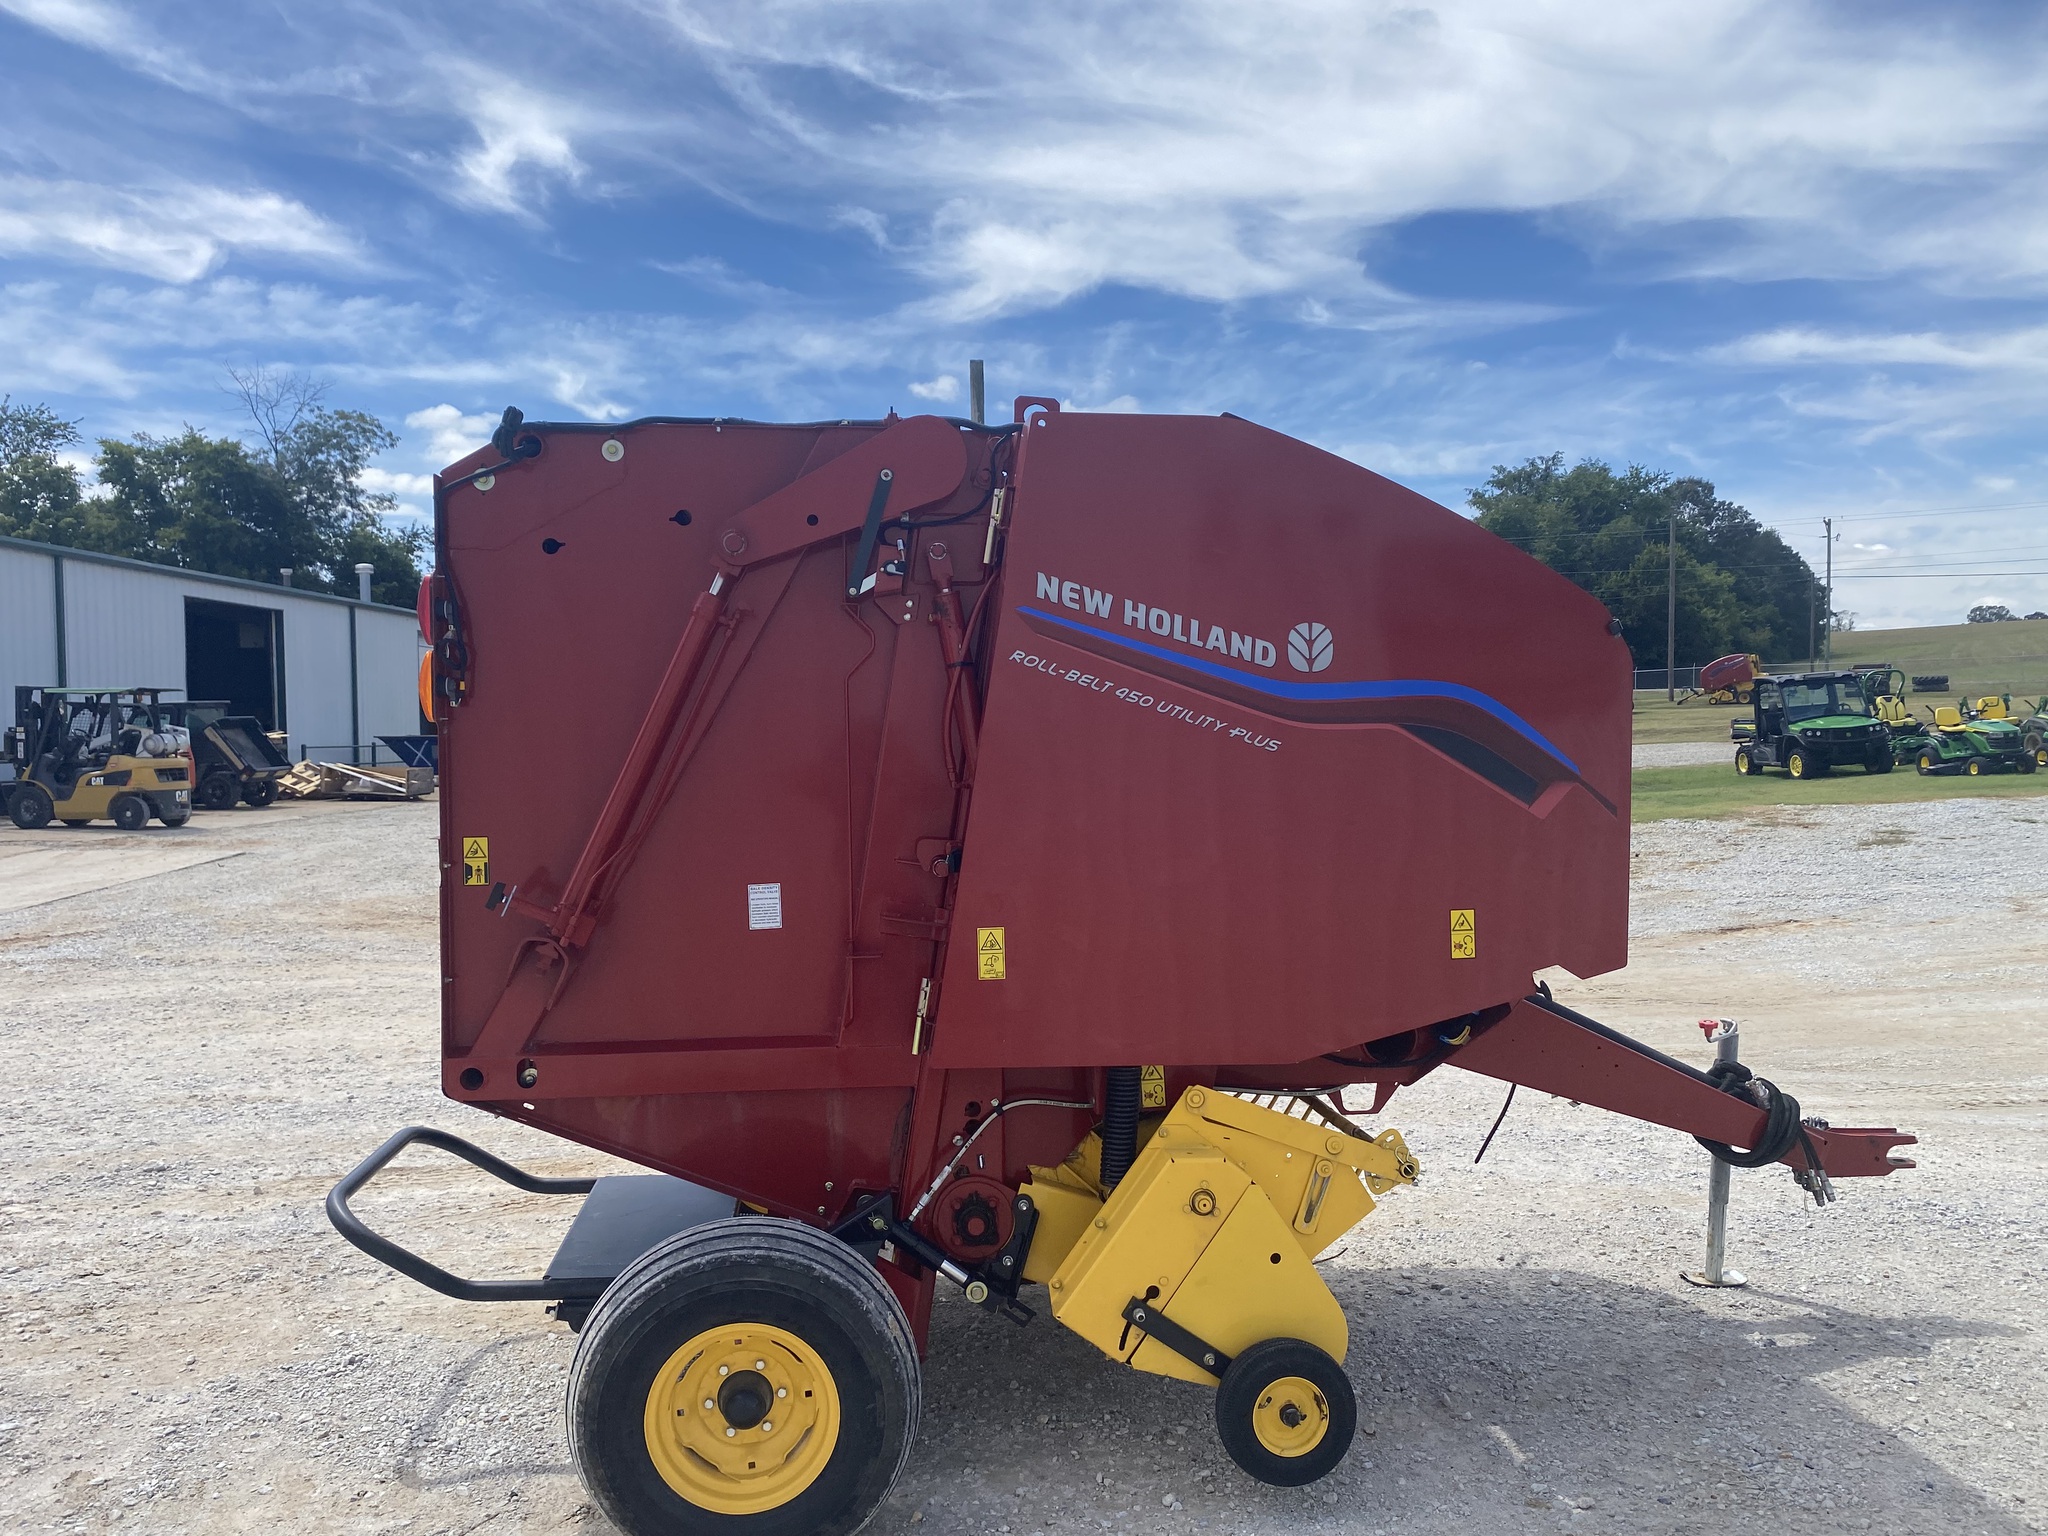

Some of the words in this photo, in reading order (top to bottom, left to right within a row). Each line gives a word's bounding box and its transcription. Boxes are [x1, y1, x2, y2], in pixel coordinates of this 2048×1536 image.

[1036, 571, 1114, 619] NEW
[1123, 598, 1277, 668] HOLLAND
[1008, 649, 1114, 693] ROLL-BELT
[1115, 687, 1154, 707] 450
[1156, 701, 1228, 732] UTILITY
[1229, 727, 1282, 752] PLUS
[91, 776, 104, 786] CAT
[175, 790, 188, 802] CAT
